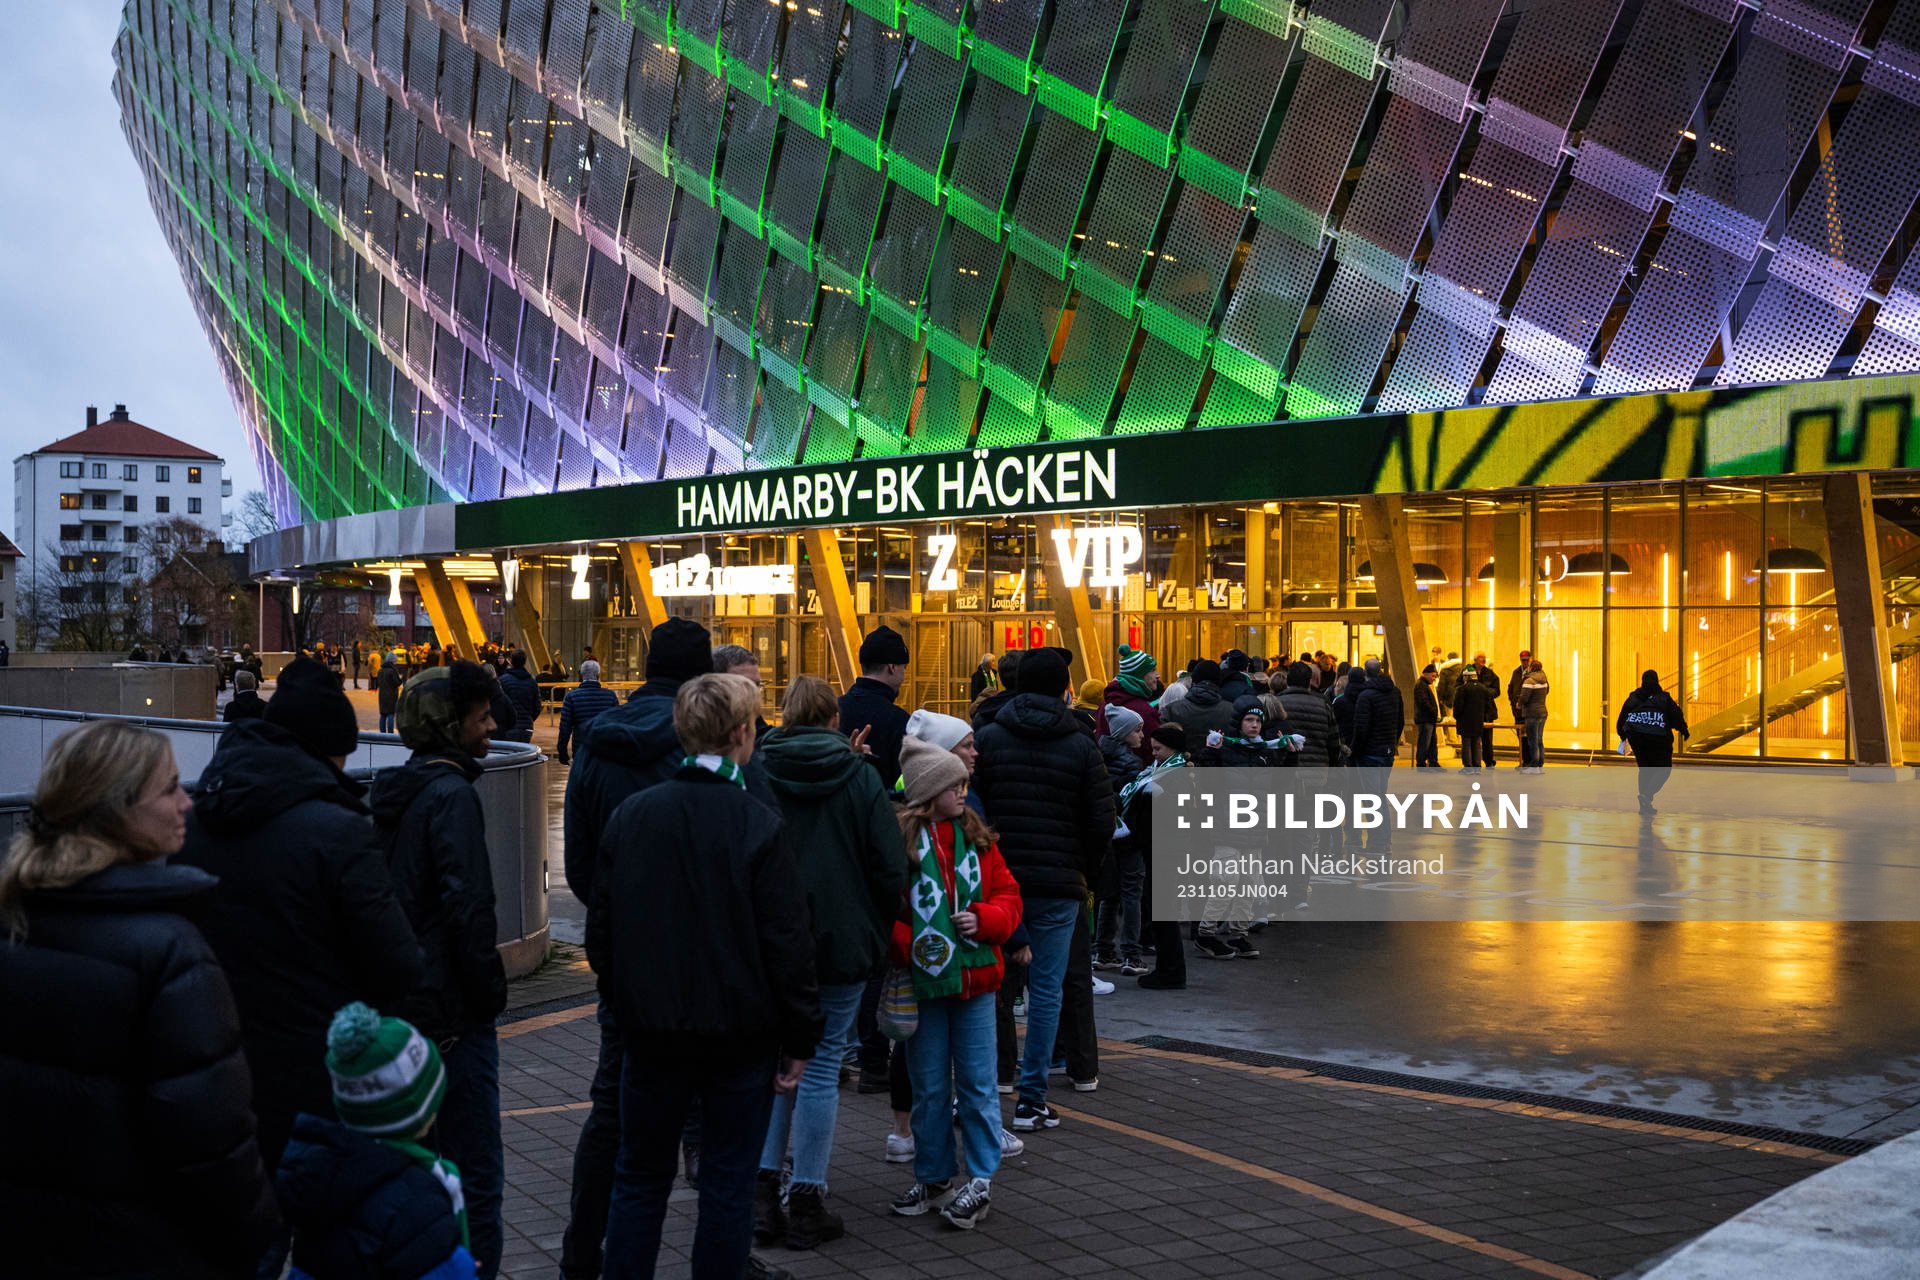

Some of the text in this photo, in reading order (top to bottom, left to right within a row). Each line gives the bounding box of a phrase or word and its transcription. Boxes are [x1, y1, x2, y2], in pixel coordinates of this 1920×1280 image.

[677, 448, 1116, 527] HAMMARBY-BK HÄCKEN
[571, 554, 591, 600] Z
[928, 534, 958, 591] Z
[1051, 526, 1143, 588] VIP
[956, 595, 1020, 611] TELE2 Lounge
